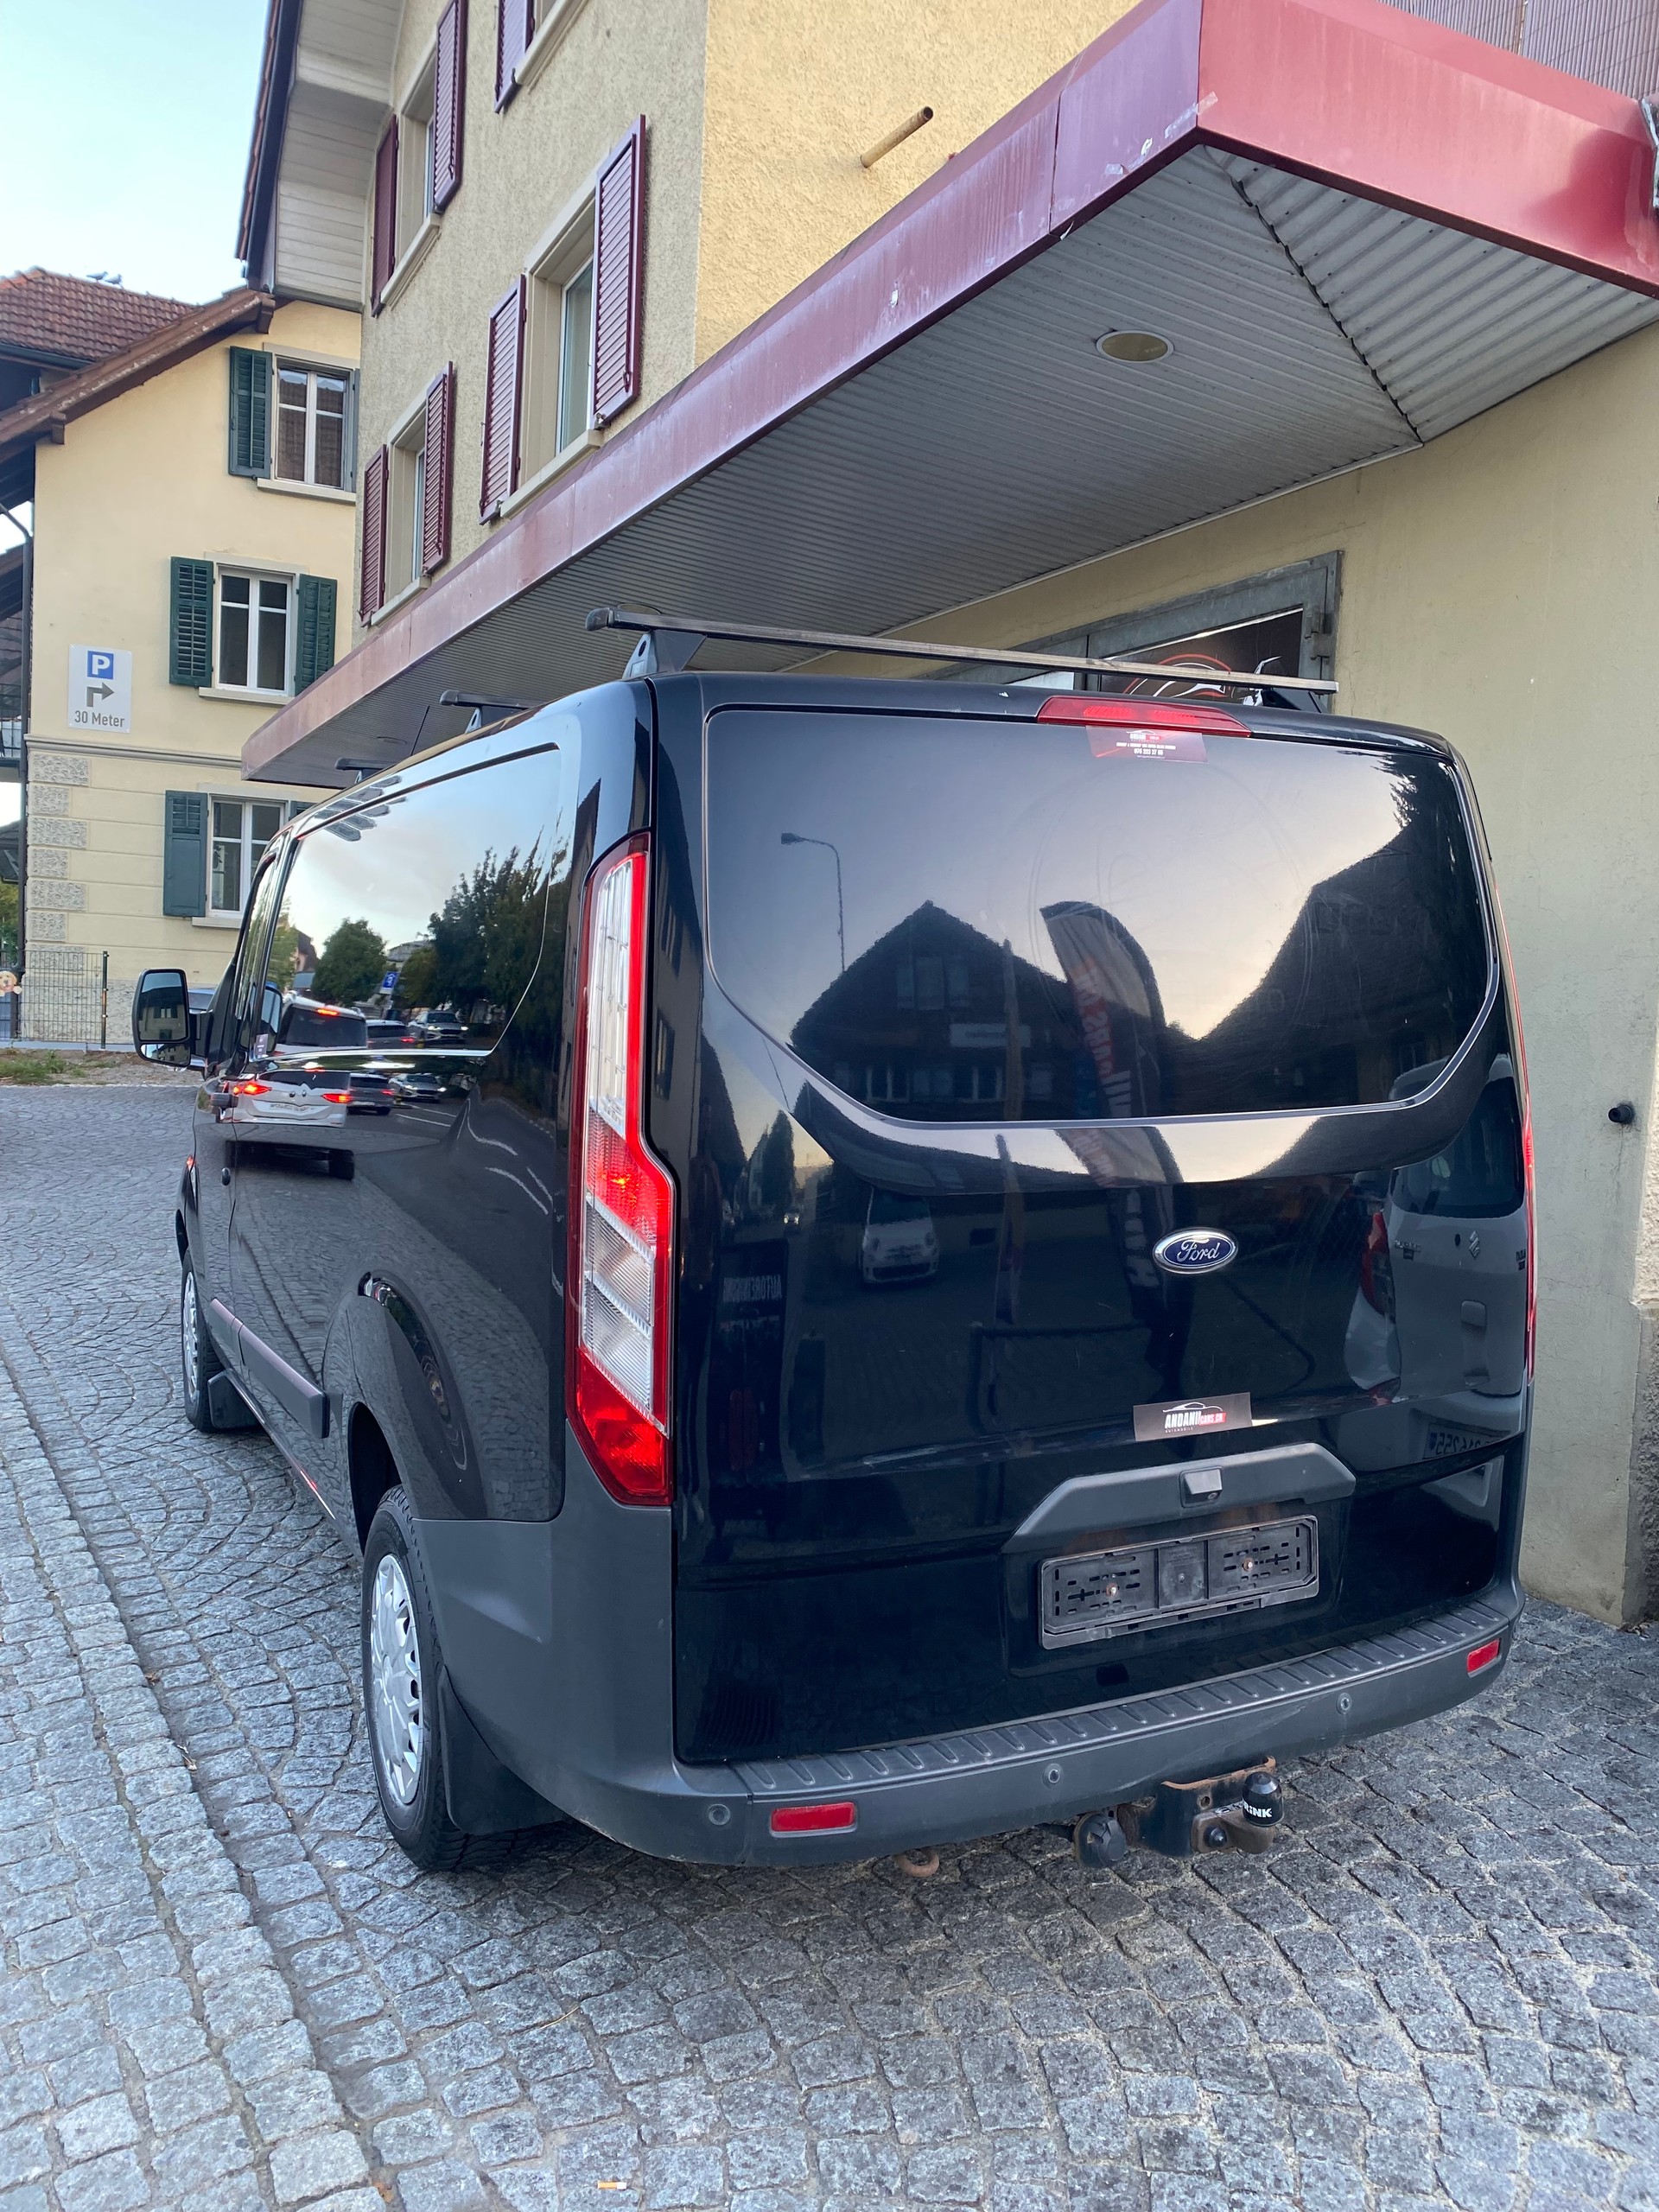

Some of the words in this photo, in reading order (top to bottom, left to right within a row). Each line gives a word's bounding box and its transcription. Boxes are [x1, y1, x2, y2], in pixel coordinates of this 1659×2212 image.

[92, 654, 111, 676] P
[74, 710, 88, 724] 30
[92, 712, 125, 728] Meter
[1177, 1238, 1221, 1262] Ford
